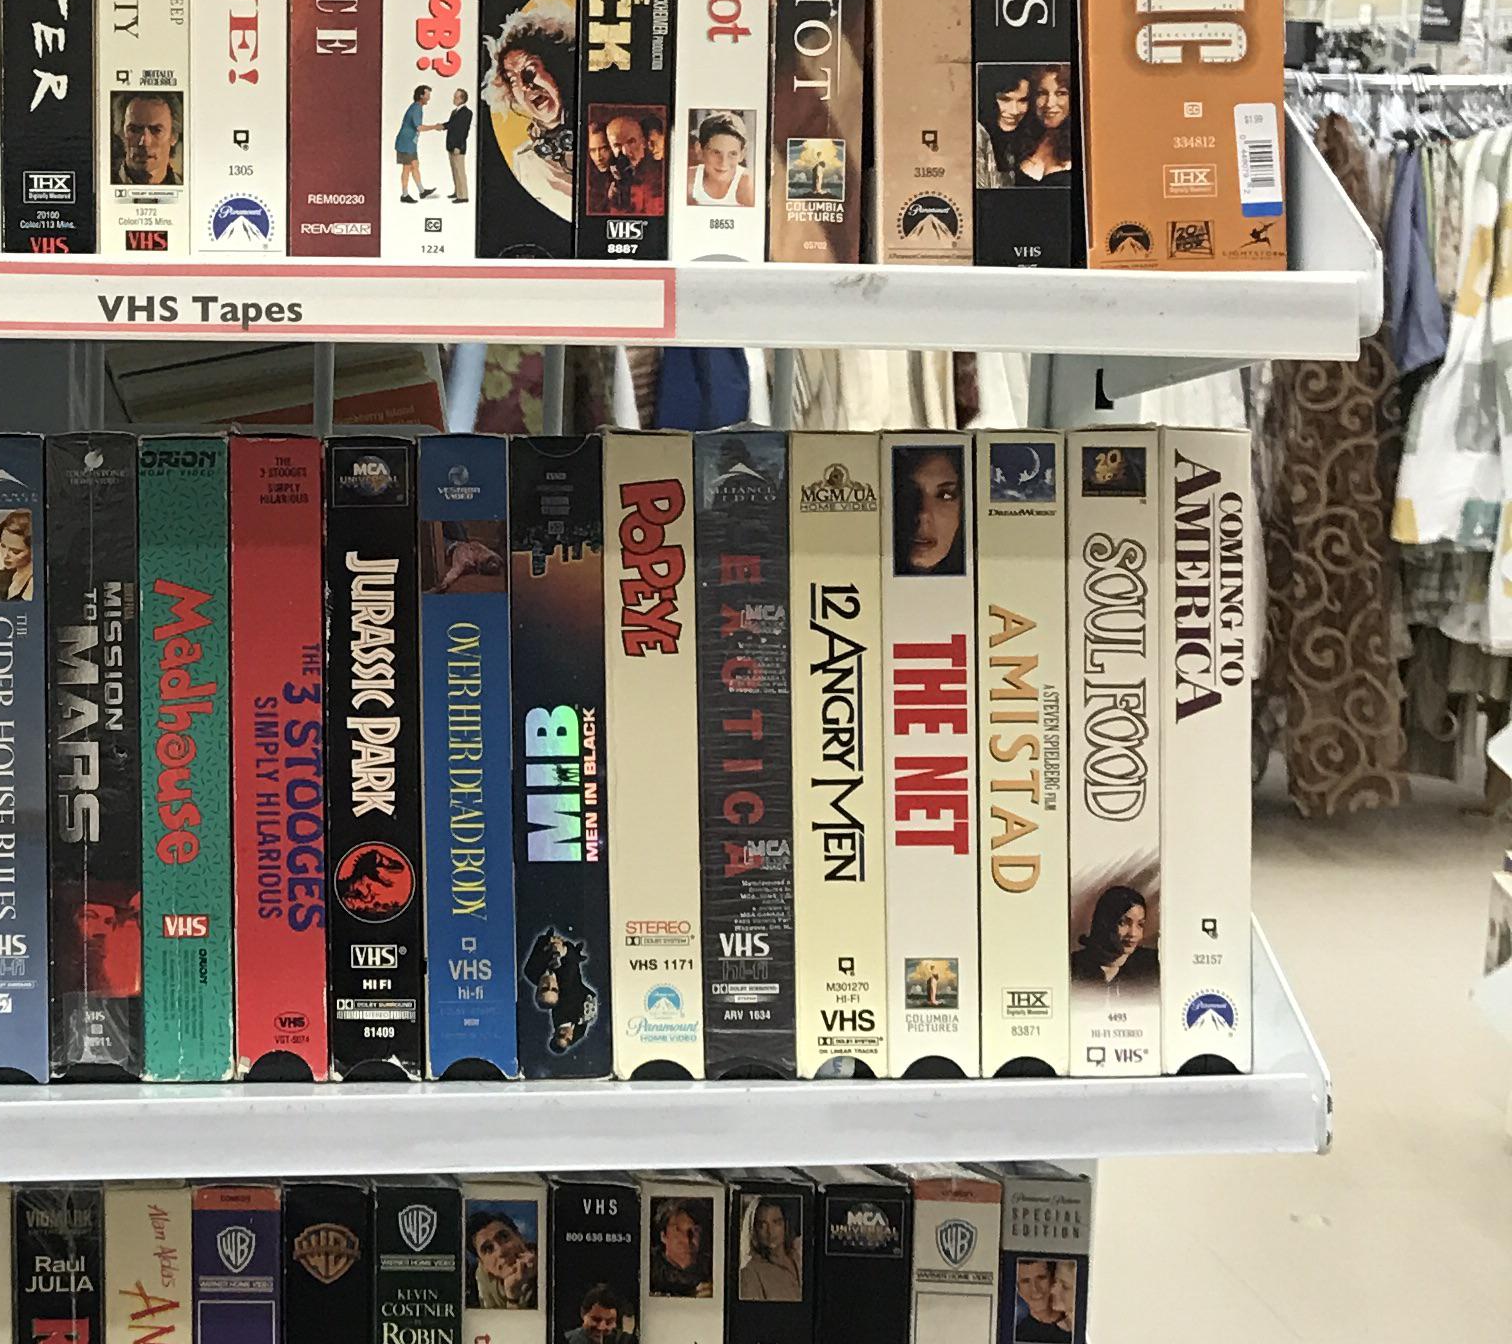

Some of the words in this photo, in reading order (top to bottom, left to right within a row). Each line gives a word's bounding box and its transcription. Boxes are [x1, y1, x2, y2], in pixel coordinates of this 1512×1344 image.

[307, 193, 364, 205] REM00230
[97, 296, 178, 321] VHS
[192, 296, 303, 330] Tapes
[821, 582, 861, 621] 12
[1083, 531, 1147, 675] SOUL
[1173, 448, 1224, 724] AMERICA
[1215, 491, 1243, 643] COMING
[810, 623, 868, 771] ANGRY
[893, 634, 968, 736] THE
[1221, 655, 1245, 688] TO
[254, 696, 277, 778] SIMPLY
[525, 705, 580, 862] MIB
[988, 604, 1040, 893] AMISTAD
[1084, 678, 1149, 822] FOOD
[255, 791, 282, 919] HILARIOUS
[812, 777, 865, 883] MEN
[894, 756, 970, 855] NET
[25, 1274, 94, 1293] JULIA
[35, 1256, 86, 1273] Raul
